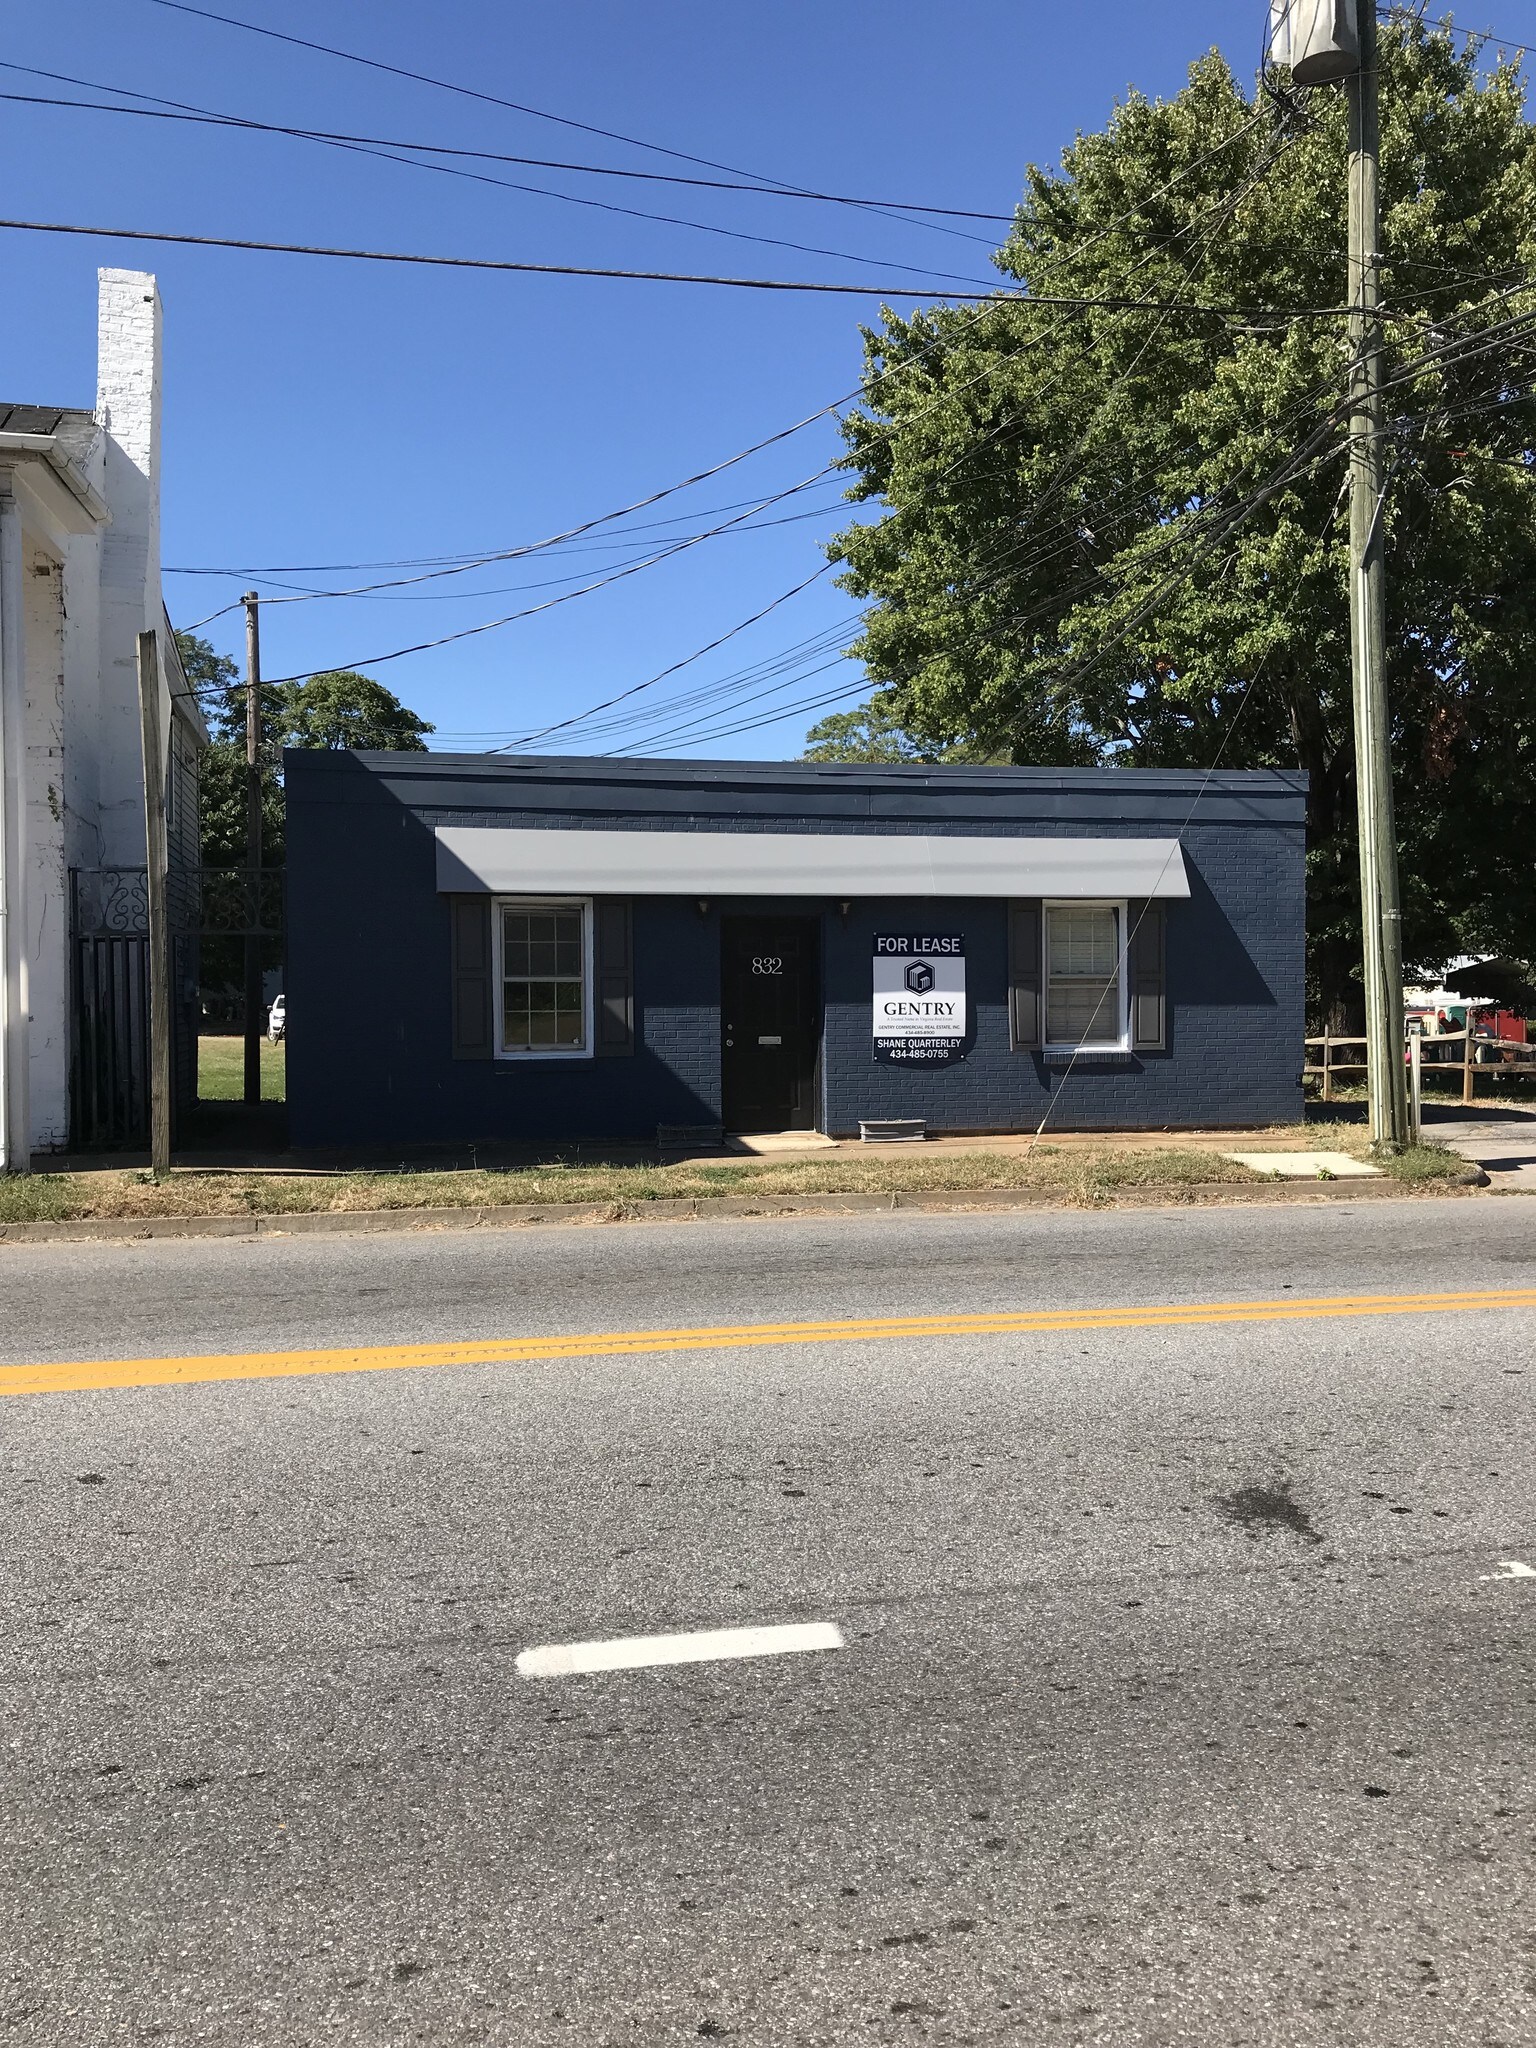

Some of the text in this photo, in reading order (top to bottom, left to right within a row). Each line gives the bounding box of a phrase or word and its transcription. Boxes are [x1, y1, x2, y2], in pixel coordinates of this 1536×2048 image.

[877, 938, 960, 952] FOR LEASE
[752, 957, 783, 975] 832
[884, 1002, 956, 1016] GENTRY
[877, 1039, 961, 1049] SHANE QUARTERLEY
[890, 1049, 949, 1058] 434-485-0755
